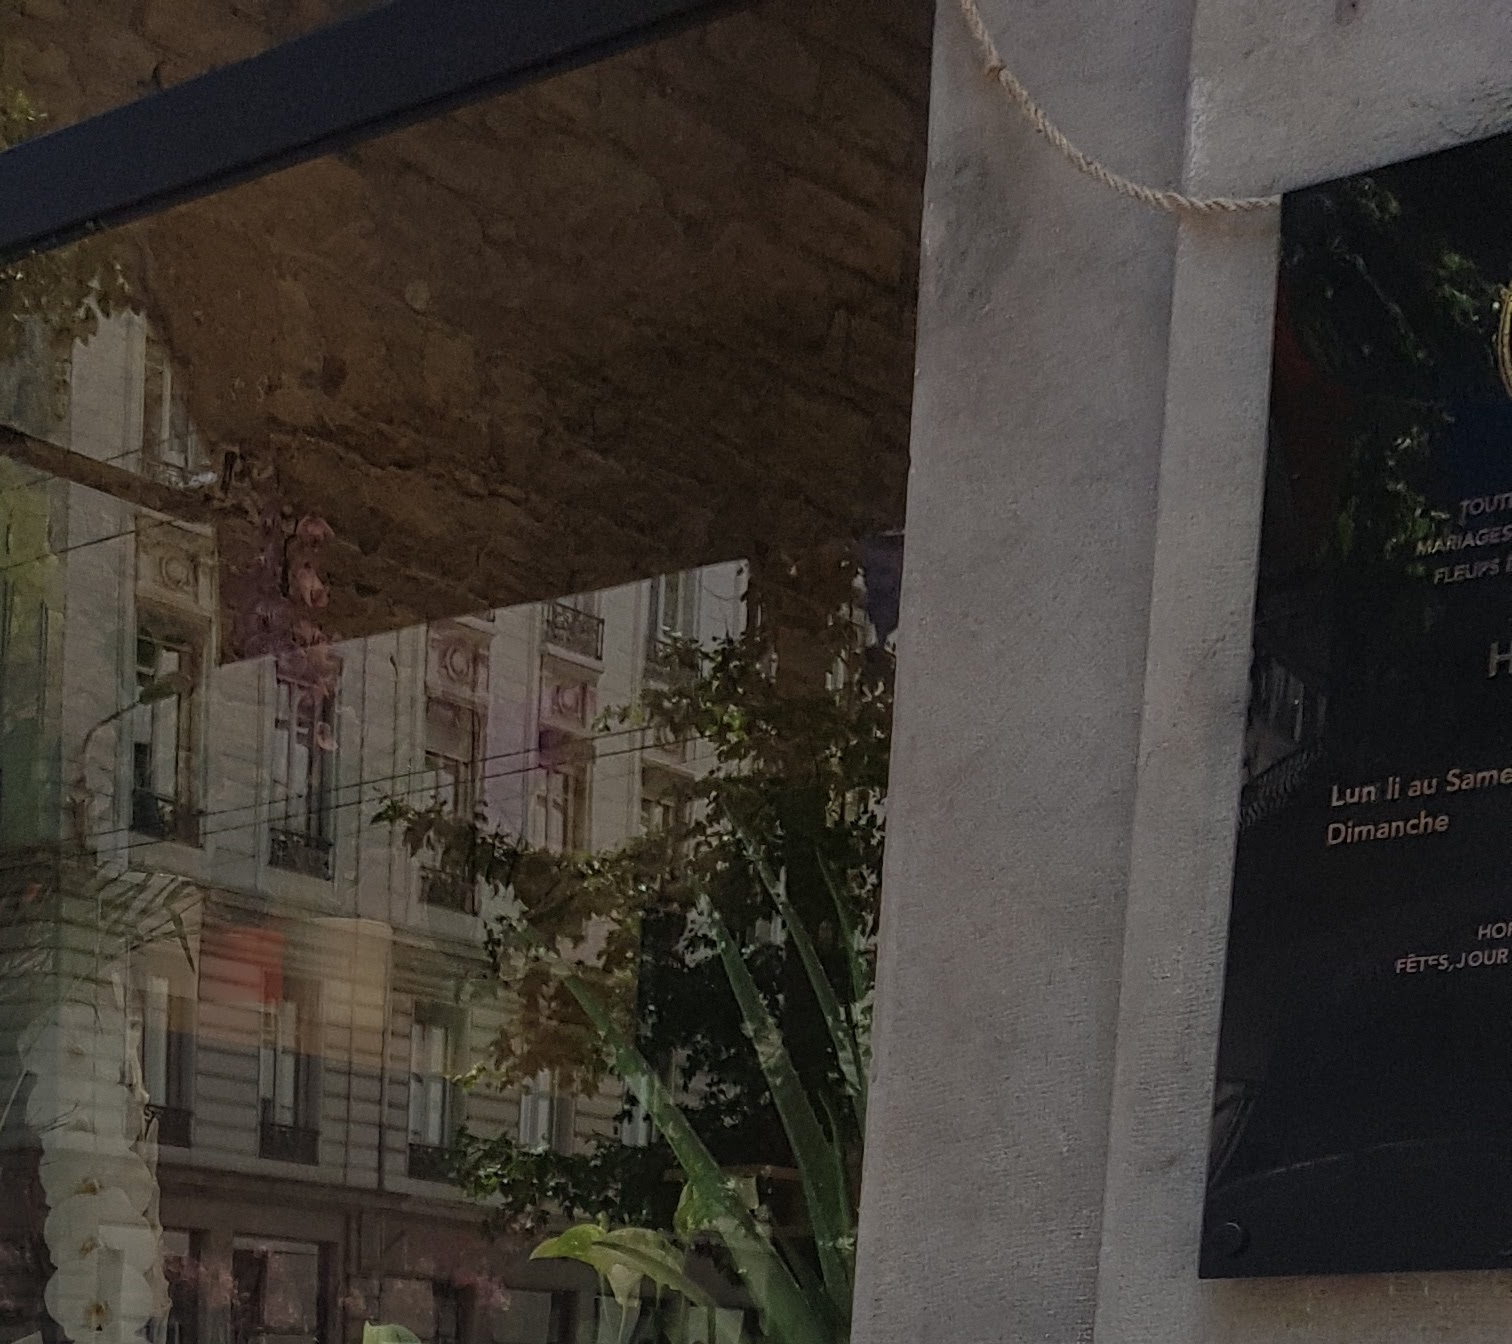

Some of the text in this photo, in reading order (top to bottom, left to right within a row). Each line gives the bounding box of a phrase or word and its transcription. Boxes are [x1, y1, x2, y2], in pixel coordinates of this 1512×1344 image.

[1459, 492, 1512, 521] TOUT
[1407, 777, 1438, 797] au
[1326, 809, 1450, 846] Dimanche
